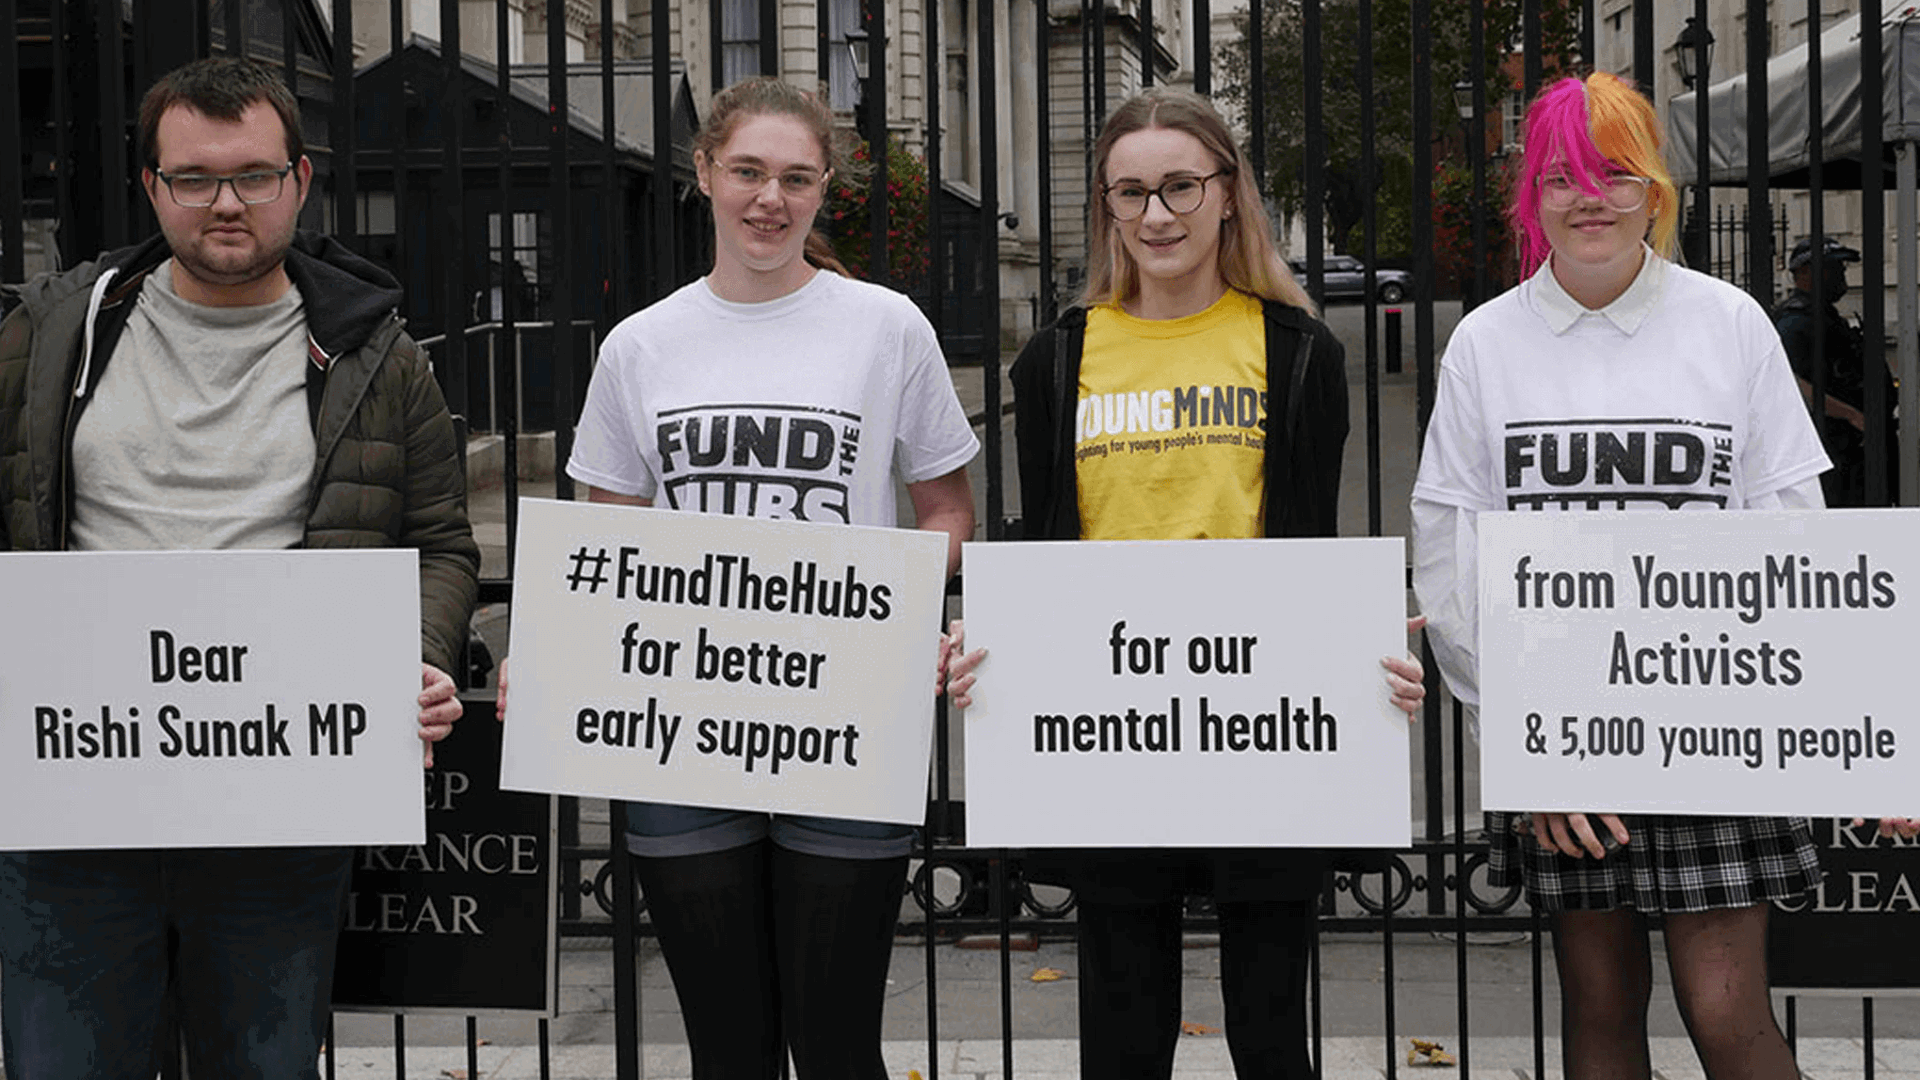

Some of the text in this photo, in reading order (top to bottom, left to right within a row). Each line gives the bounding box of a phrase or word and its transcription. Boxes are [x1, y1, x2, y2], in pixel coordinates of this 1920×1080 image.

[656, 415, 836, 474] FUND
[838, 425, 861, 477] THE
[1110, 440, 1126, 453] for
[1129, 438, 1162, 455] young
[1164, 431, 1204, 453] people's
[1206, 432, 1243, 446] mental
[1504, 431, 1705, 489] FUND
[1709, 436, 1733, 488] THE
[566, 546, 892, 621] #FundTheHubs
[1514, 554, 1896, 624] from YoungMinds
[149, 629, 248, 684] Dear
[621, 622, 827, 690] for better
[1109, 620, 1258, 675] for our
[1609, 631, 1802, 686] Activists
[34, 703, 367, 760] Rishi Sunak MP
[576, 698, 860, 775] early support
[1034, 696, 1337, 753] mental health
[1525, 712, 1895, 771] & 5,000 young people
[425, 771, 470, 810] EP
[360, 833, 539, 874] RANCE
[344, 892, 484, 935] LEAR
[1774, 871, 1920, 912] LEA
